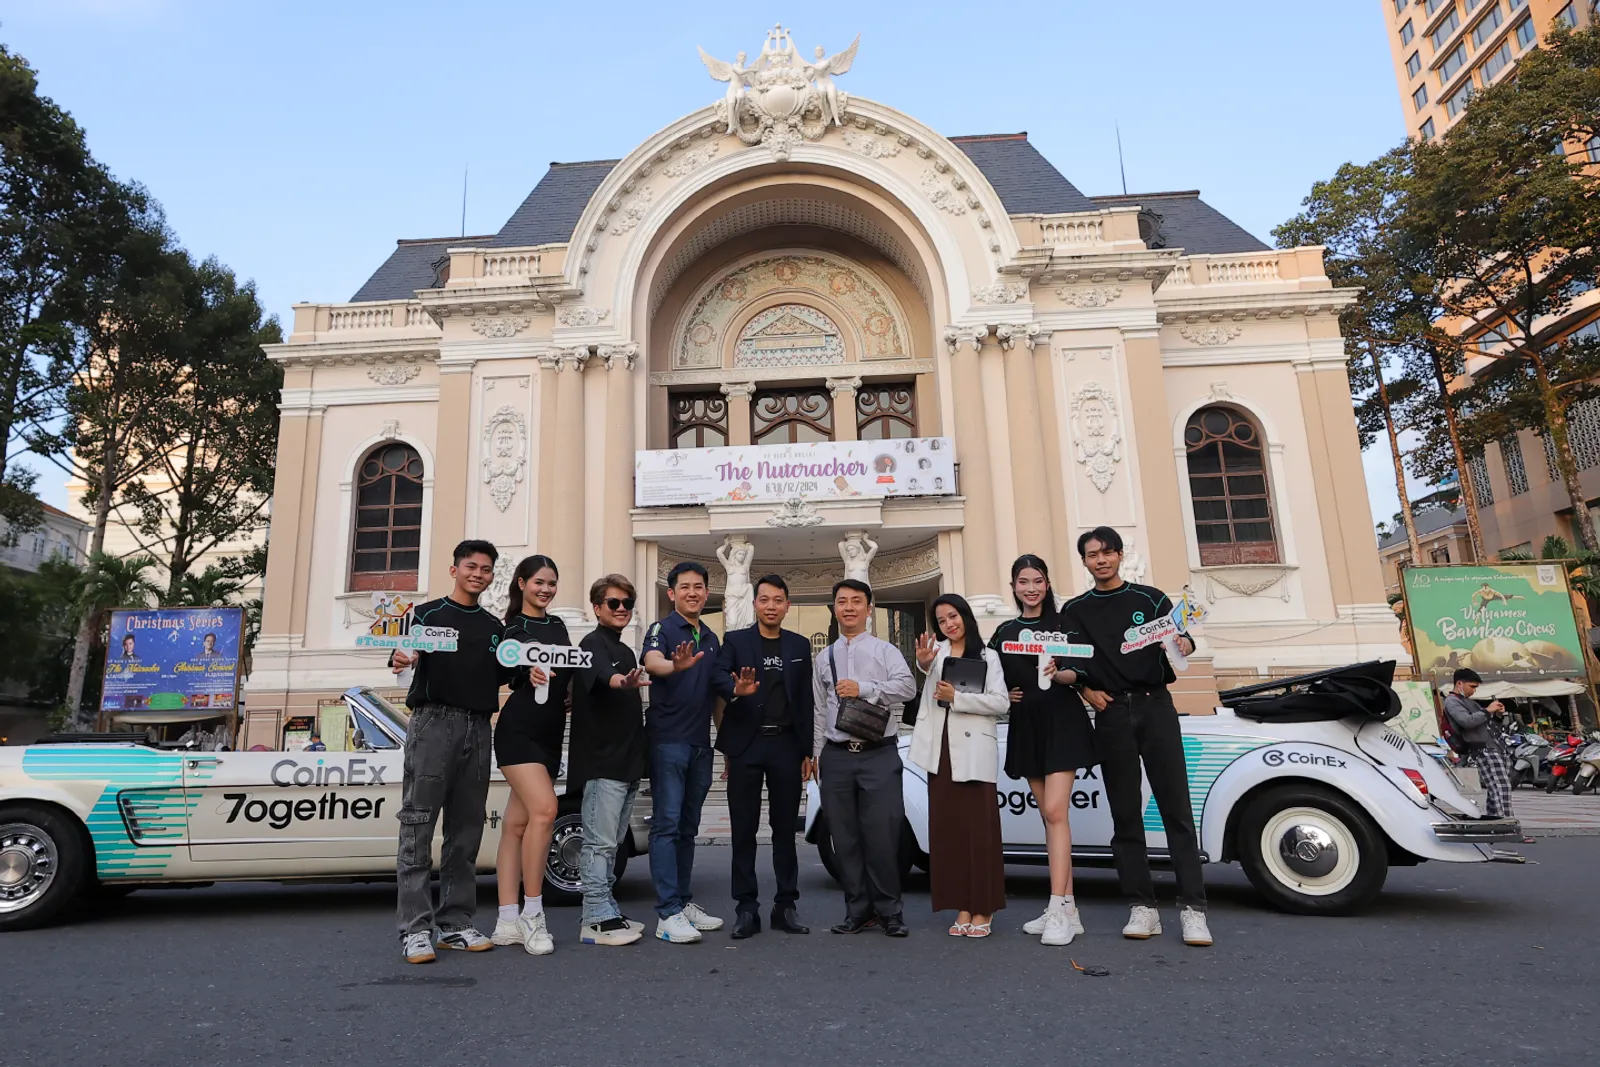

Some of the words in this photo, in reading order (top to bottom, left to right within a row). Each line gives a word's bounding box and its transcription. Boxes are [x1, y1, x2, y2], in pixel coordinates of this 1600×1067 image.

[715, 461, 752, 483] The
[757, 456, 868, 481] Nutcracker
[1460, 604, 1527, 620] Vietnamese
[126, 615, 185, 632] Christmas
[187, 615, 224, 631] Series
[1139, 618, 1173, 636] CoinEx
[1436, 616, 1514, 641] Bamboo
[1516, 620, 1556, 636] Circus
[356, 636, 398, 648] #Team
[424, 628, 458, 639] CoinEx
[1034, 632, 1066, 643] CoinEx
[526, 646, 591, 667] CoinEx
[1004, 642, 1024, 652] FOMO
[1025, 643, 1045, 654] LESS,
[1287, 751, 1348, 769] CoinEx
[271, 758, 387, 787] CoinEx
